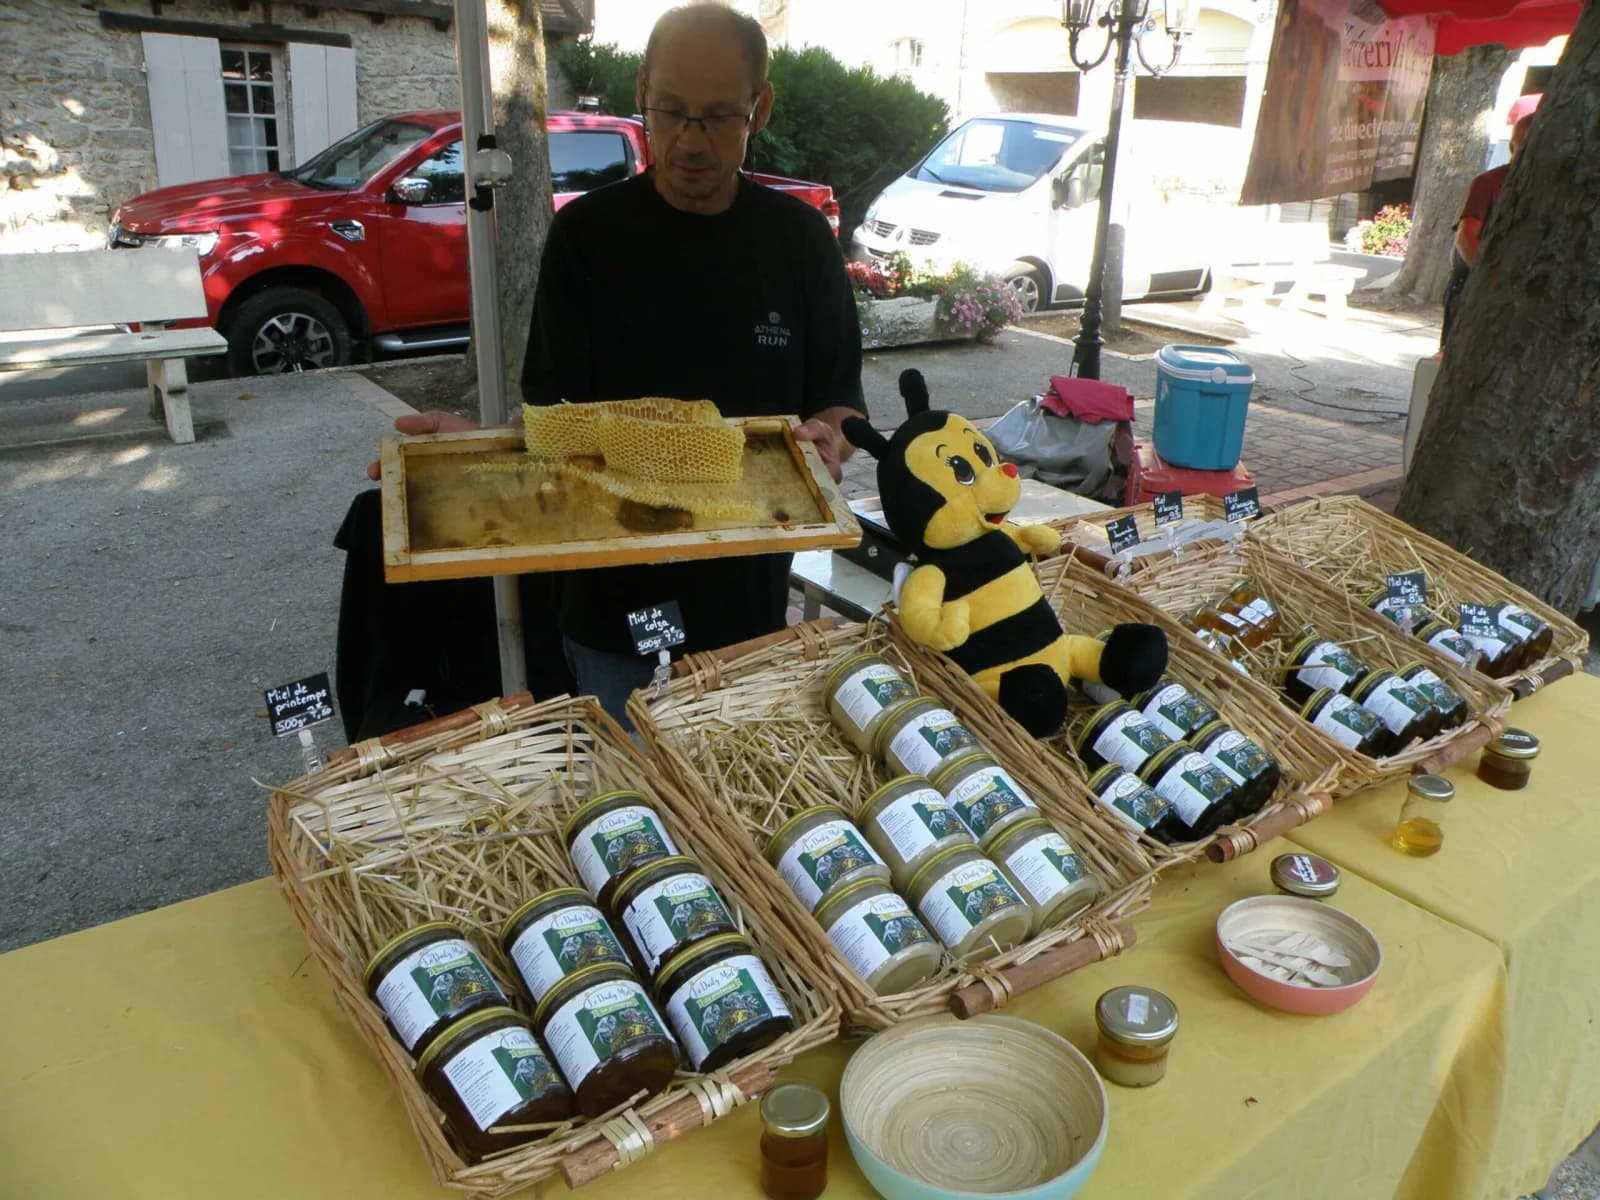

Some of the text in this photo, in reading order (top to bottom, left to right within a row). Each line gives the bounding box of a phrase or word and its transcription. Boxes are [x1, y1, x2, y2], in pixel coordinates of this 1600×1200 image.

[754, 324, 791, 336] ATHENA
[758, 336, 788, 346] RUN
[1388, 576, 1412, 586] Miel de
[1461, 604, 1486, 616] Miel de
[628, 608, 662, 626] Miel de
[644, 620, 670, 632] colza
[638, 638, 662, 650] 500gr
[268, 682, 308, 704] Miel de
[275, 688, 327, 716] printemps
[277, 717, 307, 732] 500gr
